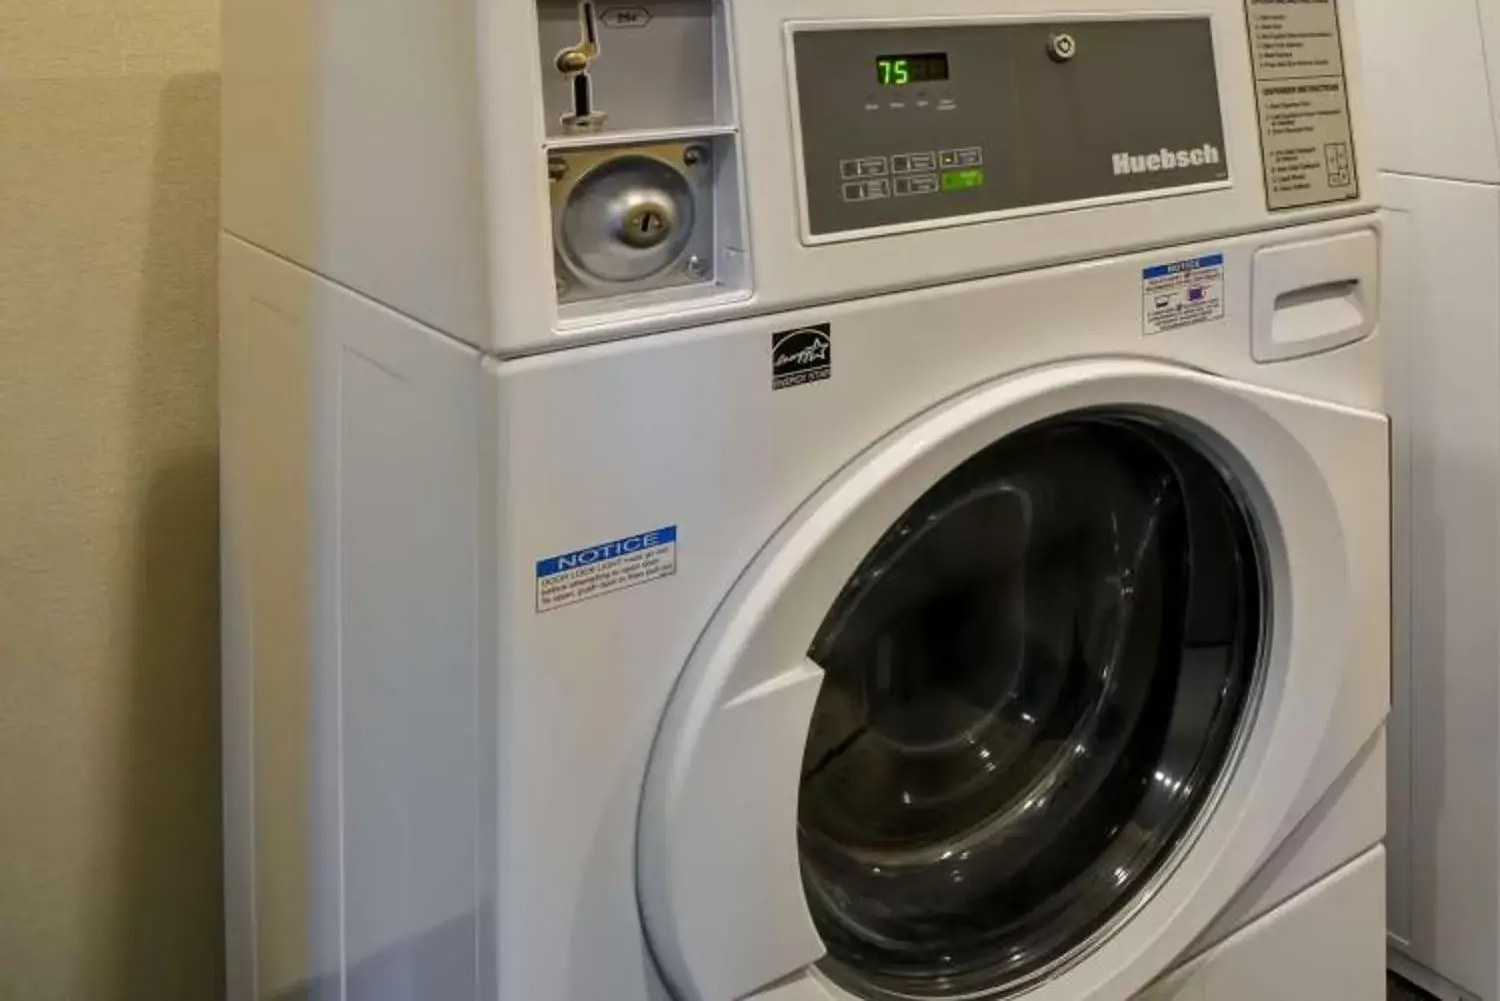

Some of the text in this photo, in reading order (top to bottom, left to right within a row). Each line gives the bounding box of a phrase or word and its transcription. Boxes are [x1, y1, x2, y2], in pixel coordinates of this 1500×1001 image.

[879, 60, 908, 85] 75
[1111, 144, 1219, 176] Huebsch
[558, 532, 662, 570] NOTICE
